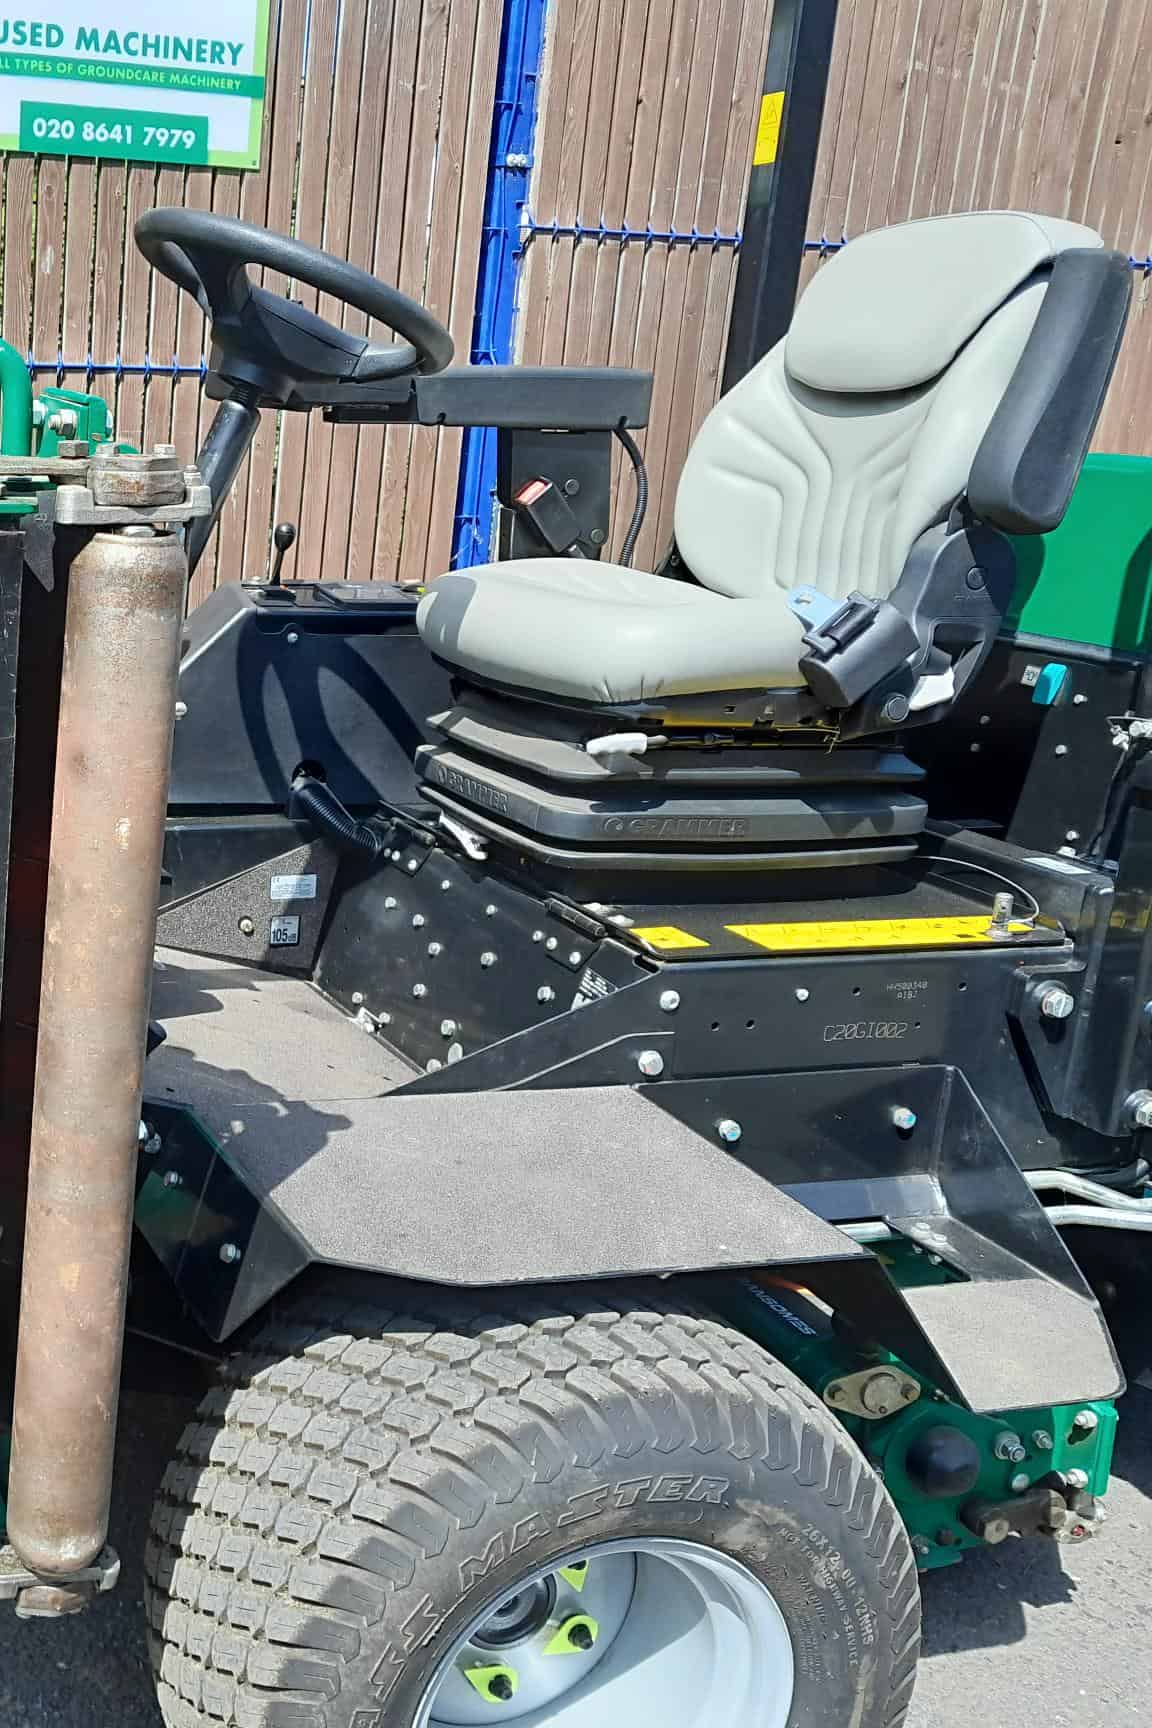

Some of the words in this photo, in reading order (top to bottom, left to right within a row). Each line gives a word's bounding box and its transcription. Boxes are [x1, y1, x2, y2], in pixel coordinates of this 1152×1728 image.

[75, 26, 244, 66] MACHINERY
[15, 58, 53, 73] TYPES
[56, 62, 74, 74] OF
[77, 64, 166, 83] GROUNDCARE
[170, 73, 242, 90] MACHINERY
[32, 117, 75, 139] 020
[81, 123, 133, 144] 8641
[143, 126, 196, 149] 7979
[271, 928, 288, 942] 105
[458, 1473, 730, 1592] MASTER
